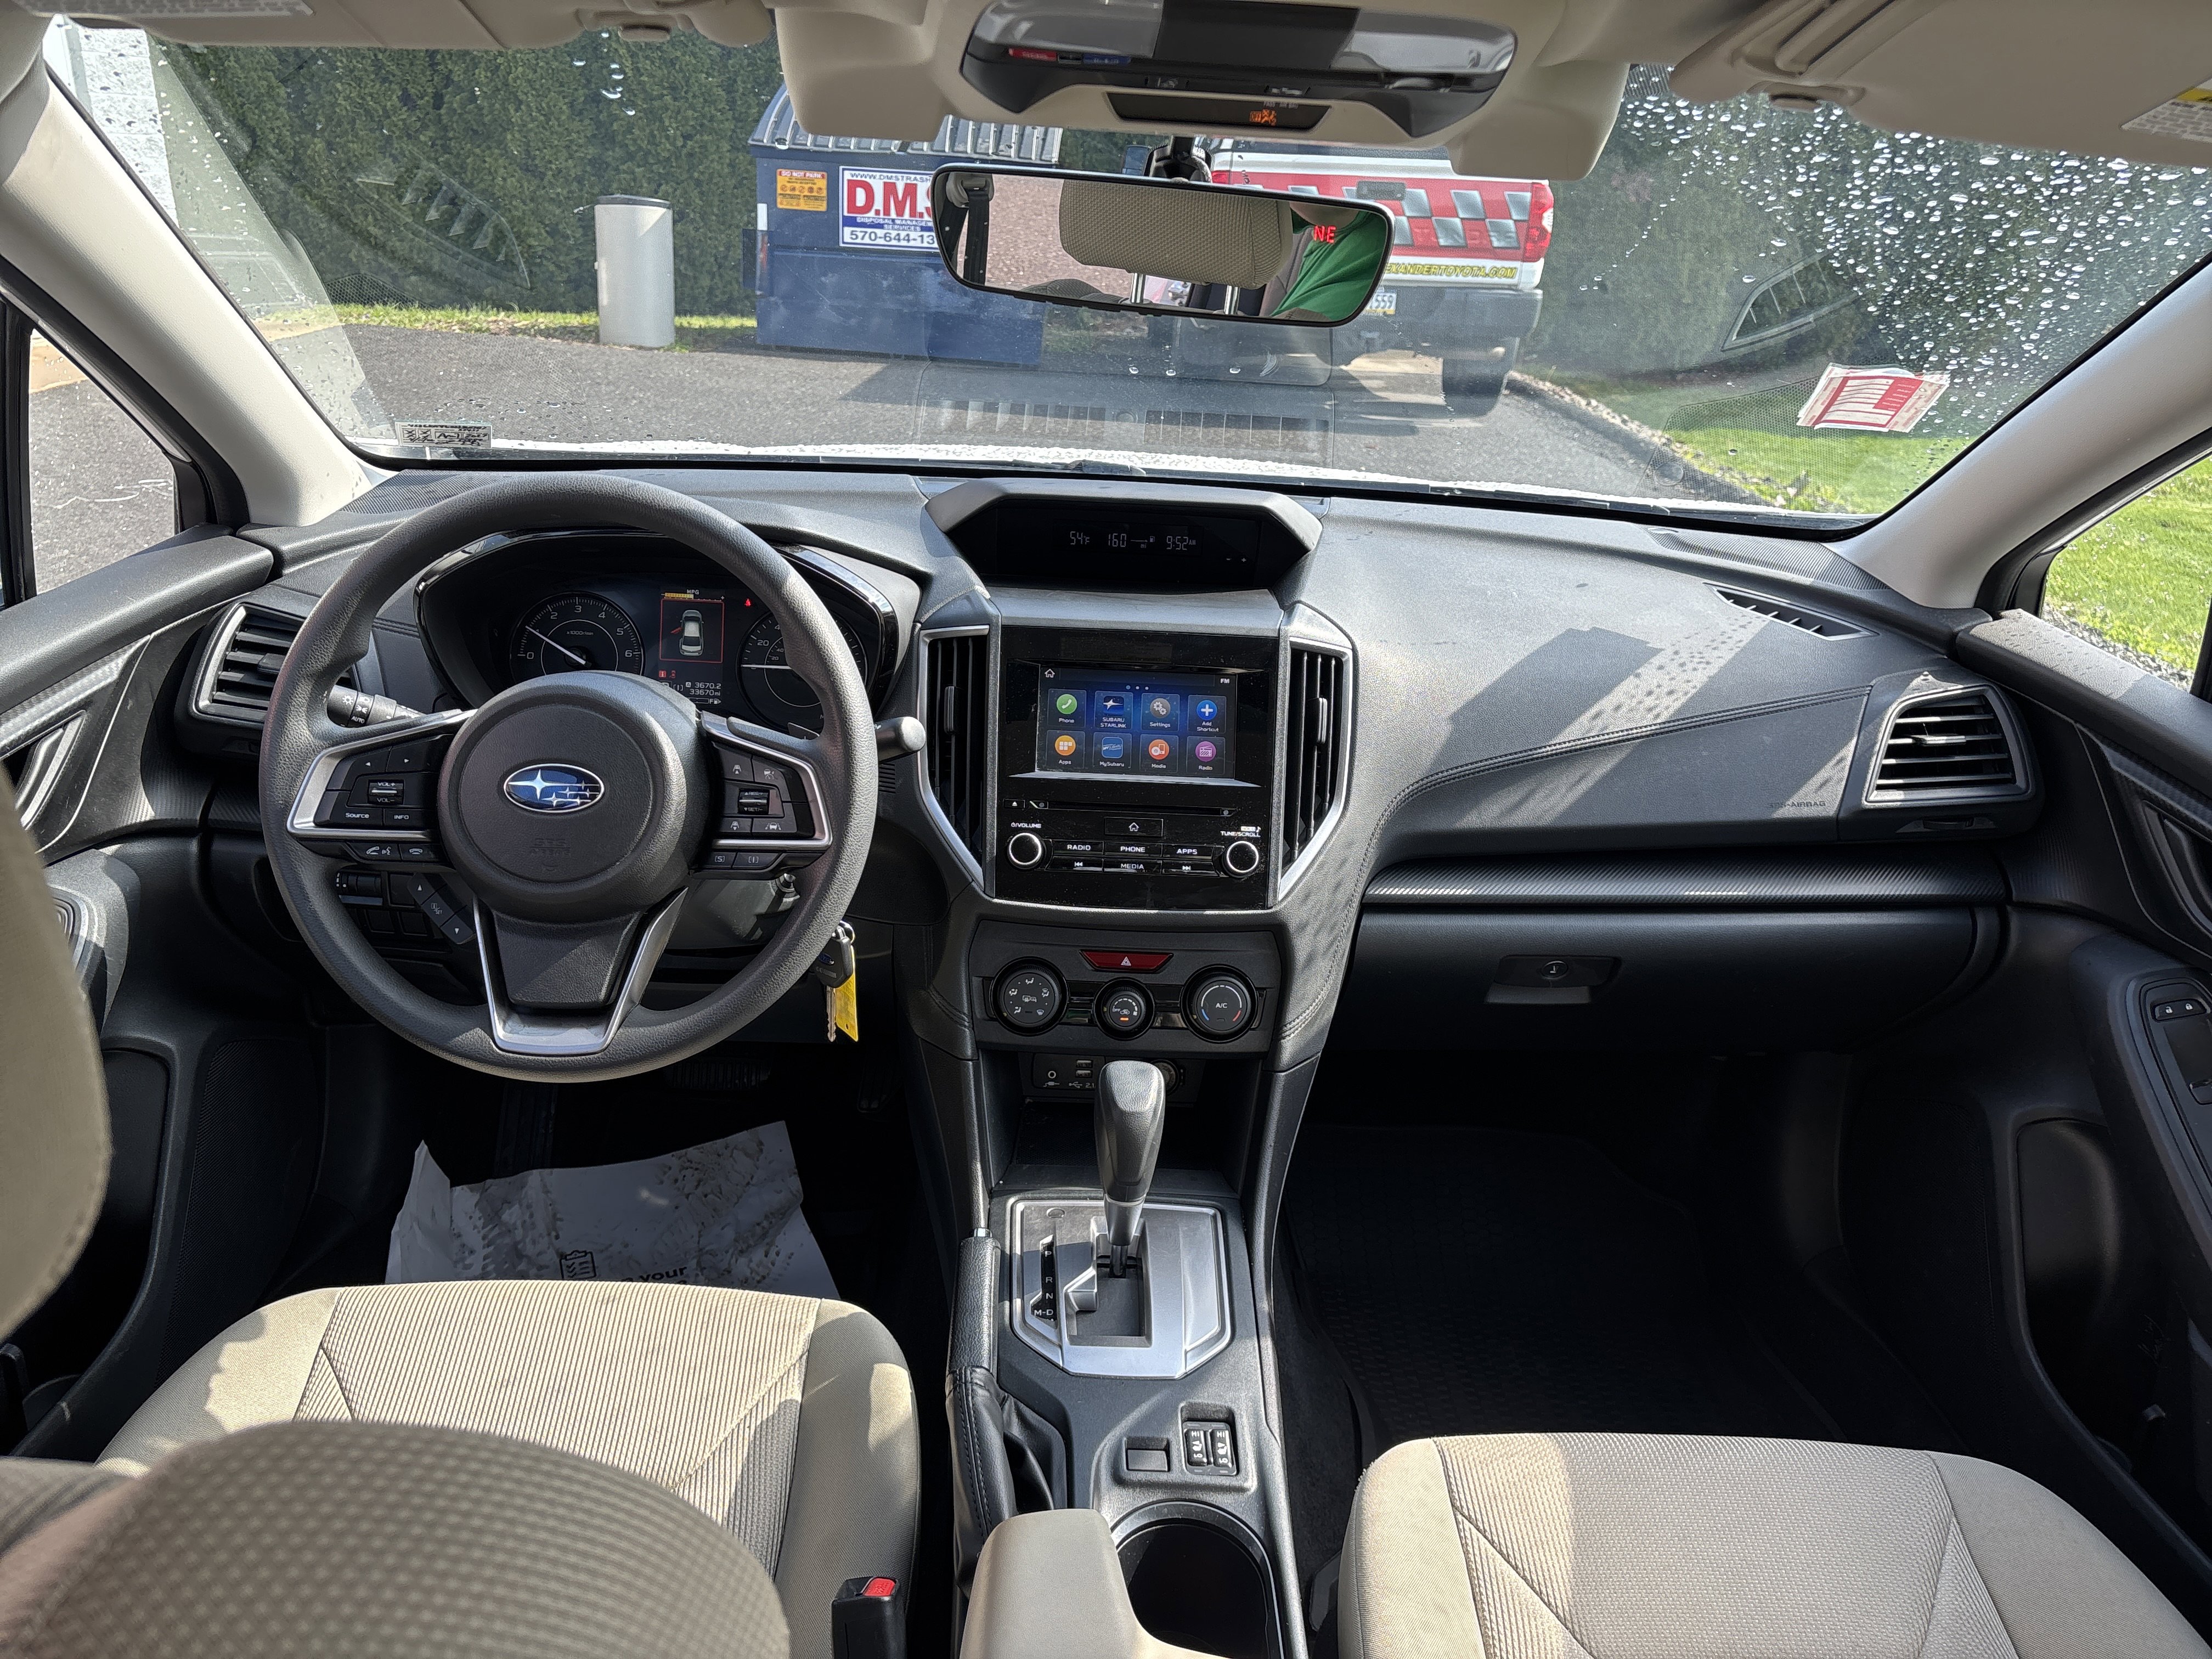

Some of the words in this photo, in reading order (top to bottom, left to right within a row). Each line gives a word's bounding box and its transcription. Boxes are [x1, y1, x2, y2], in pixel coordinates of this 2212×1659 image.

[1314, 225, 1336, 244] NE
[1369, 294, 1394, 309] 559
[1108, 533, 1126, 548] 160
[1166, 535, 1188, 550] 9:52
[616, 628, 624, 636] 5
[351, 715, 365, 724] AUTO
